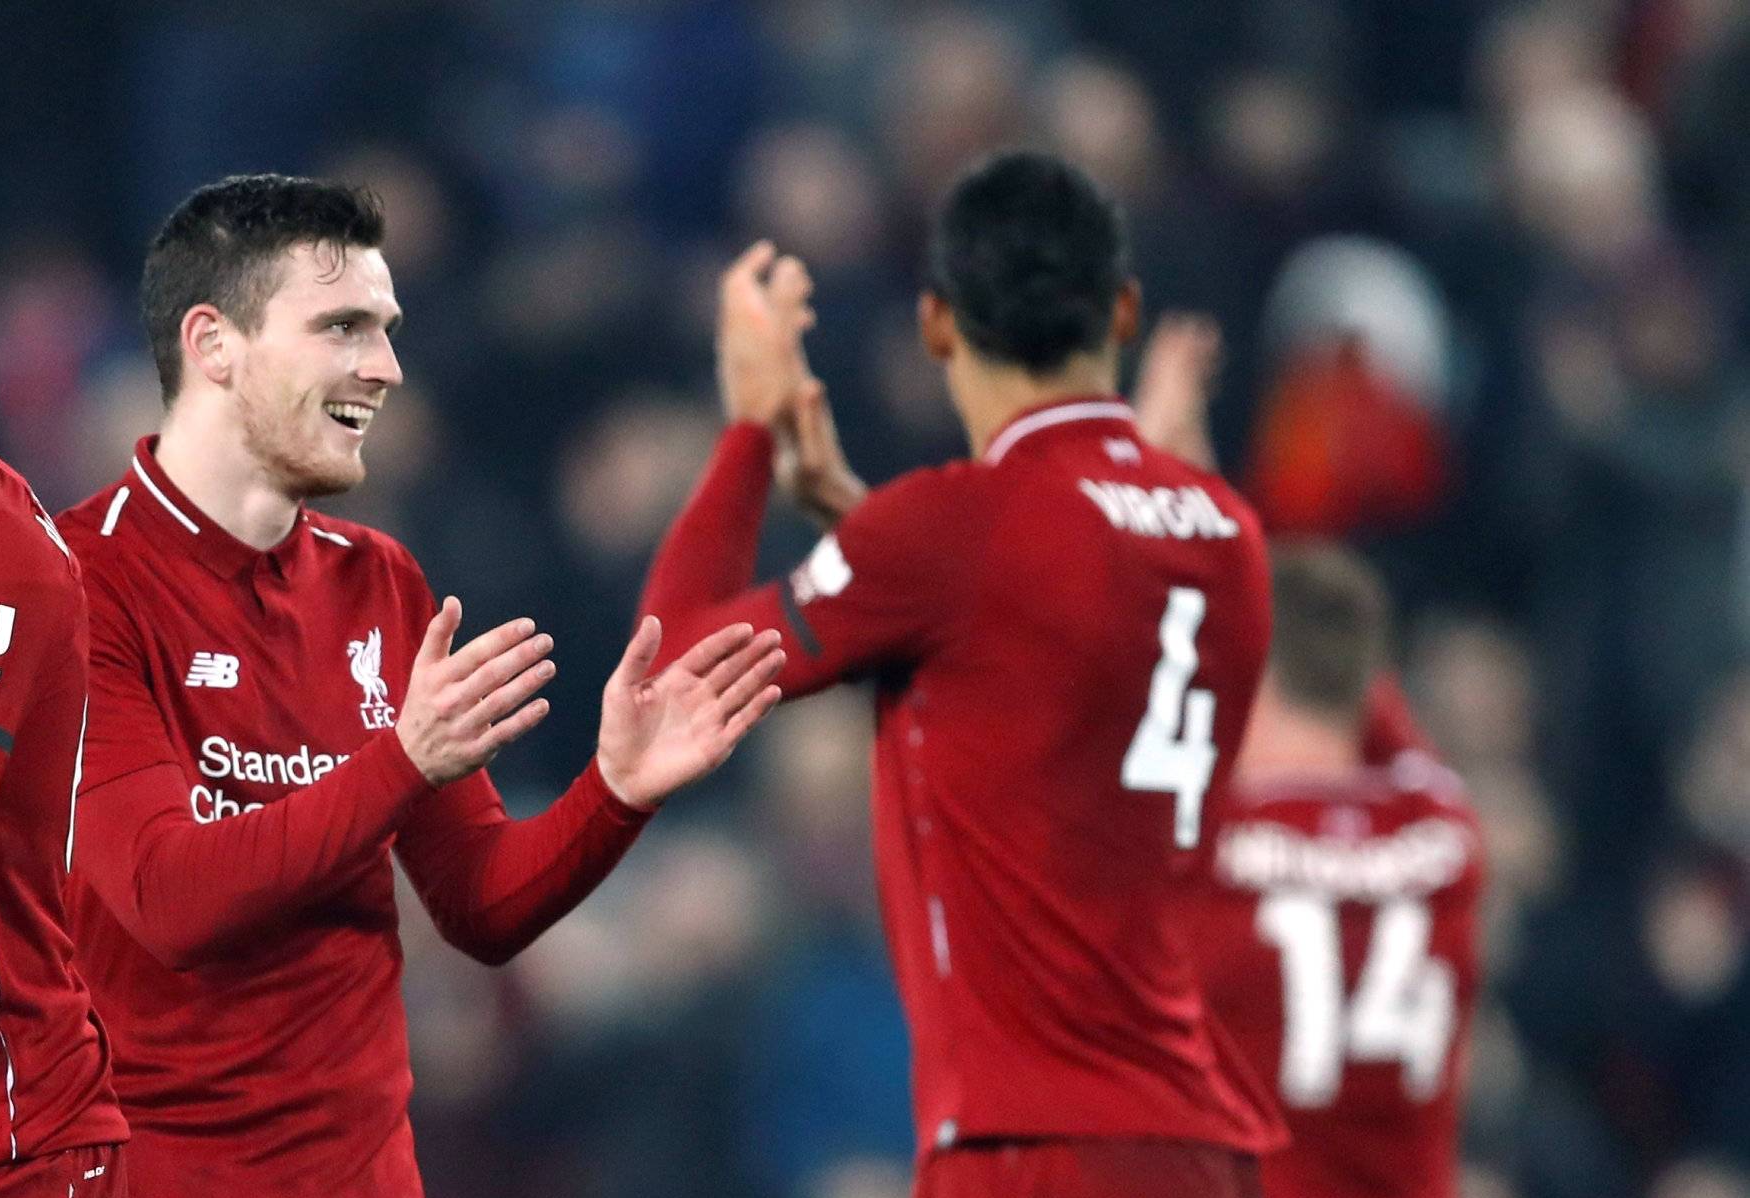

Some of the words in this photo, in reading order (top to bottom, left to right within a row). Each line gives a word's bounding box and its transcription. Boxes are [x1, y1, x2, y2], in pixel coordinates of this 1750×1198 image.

[199, 735, 351, 786] Standa
[1121, 587, 1218, 849] 4
[1255, 895, 1456, 1110] 14
